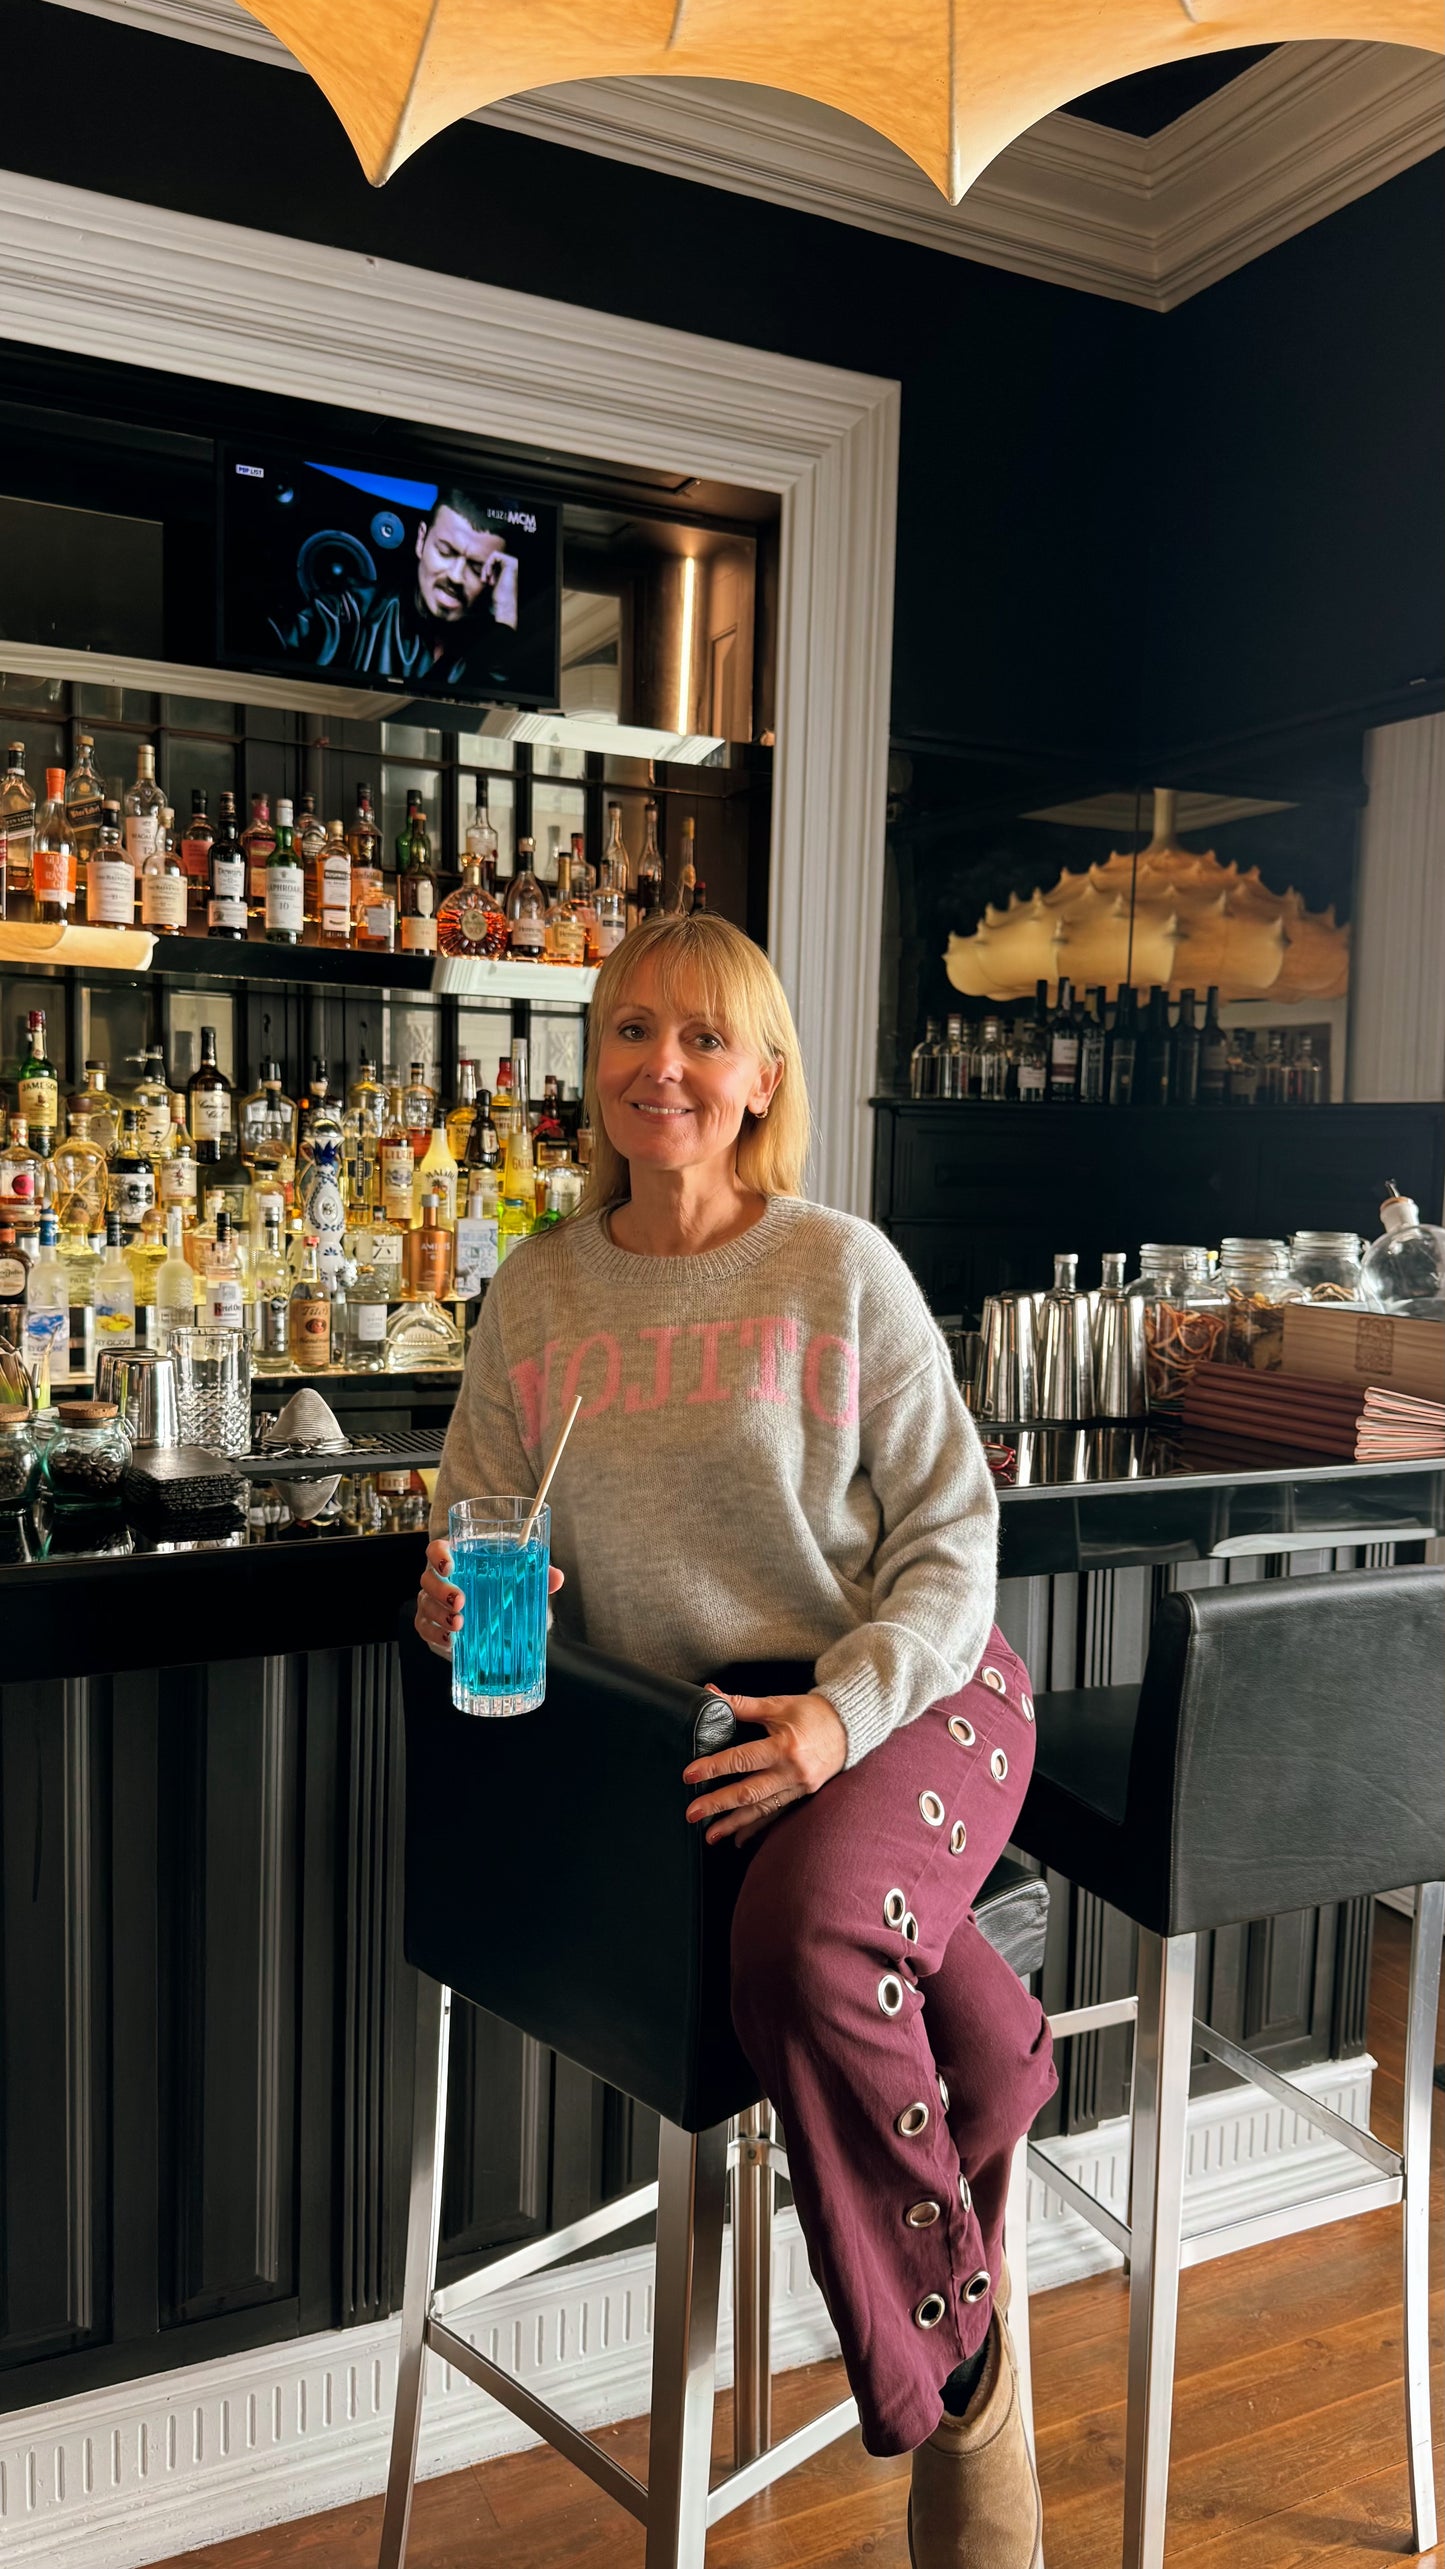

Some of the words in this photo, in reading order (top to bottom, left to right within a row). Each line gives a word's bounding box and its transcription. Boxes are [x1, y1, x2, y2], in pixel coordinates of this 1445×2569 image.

[508, 510, 537, 528] MCM
[143, 846, 153, 855] 12
[279, 901, 290, 910] 10
